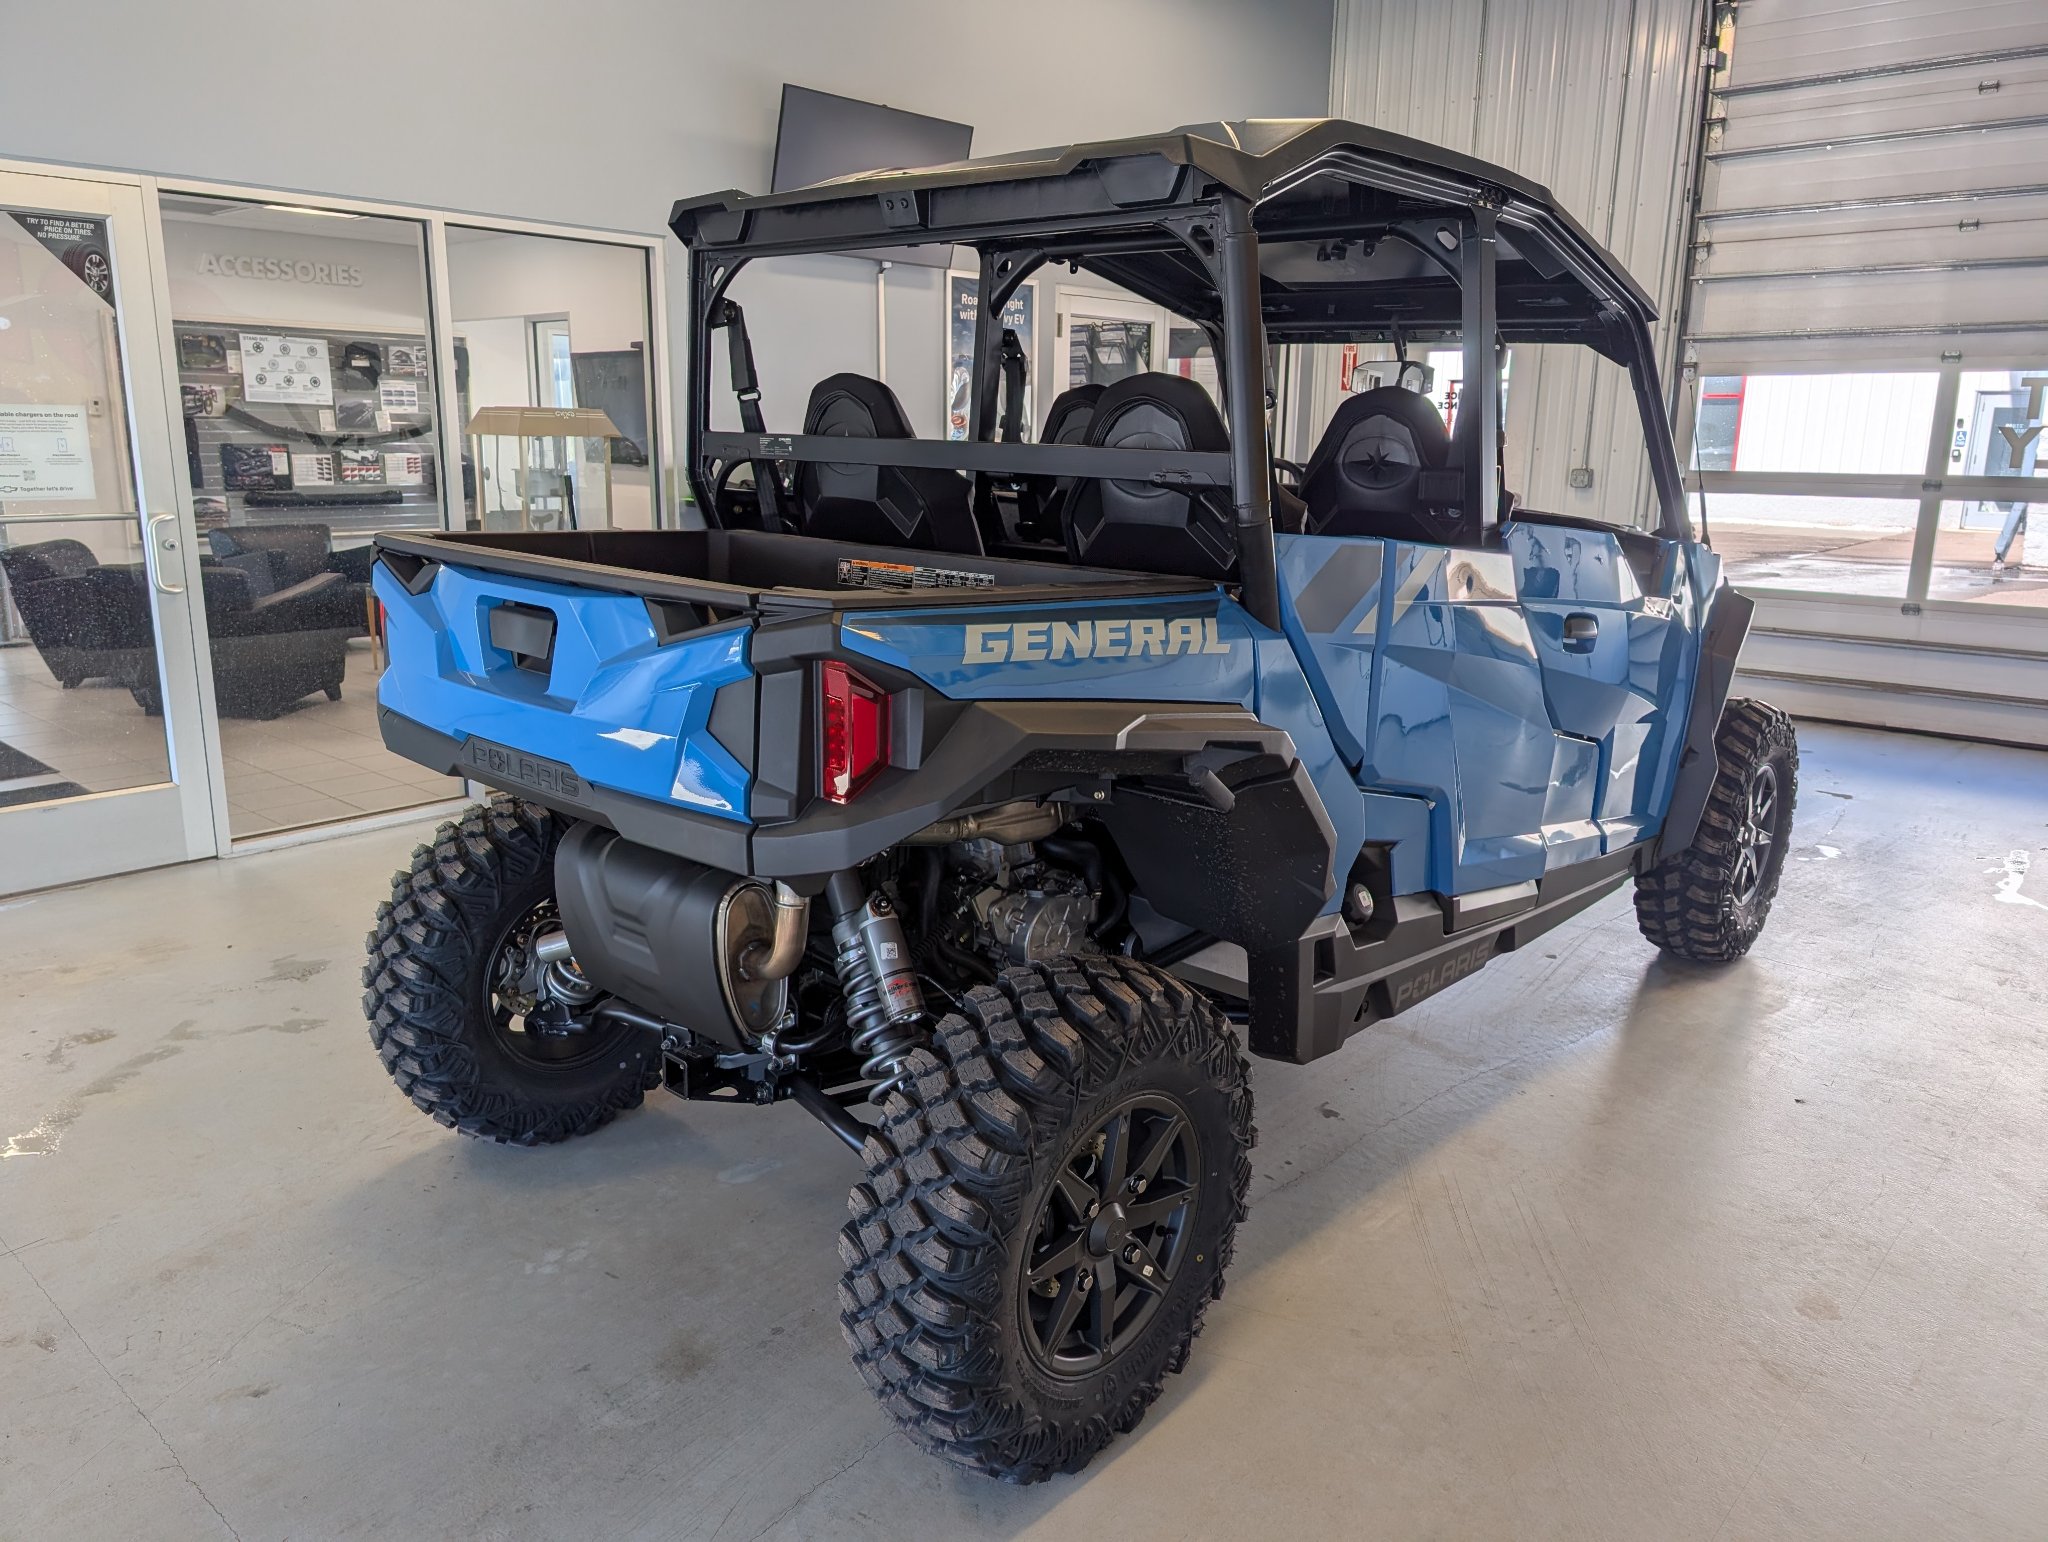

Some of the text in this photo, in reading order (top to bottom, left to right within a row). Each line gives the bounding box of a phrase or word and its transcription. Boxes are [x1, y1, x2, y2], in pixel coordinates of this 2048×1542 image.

[43, 225, 63, 233] PRICE
[73, 228, 94, 236] TIRES.
[49, 219, 65, 227] FIND
[70, 221, 95, 230] BETTER
[47, 232, 82, 241] PRESSURE.
[200, 252, 364, 287] ACCESSORIES
[961, 293, 979, 306] Roa
[1014, 313, 1025, 325] EV
[15, 411, 43, 419] chargers
[962, 617, 1231, 665] GENERAL
[472, 742, 580, 798] POLARIS
[1394, 941, 1491, 1010] POLARIS
